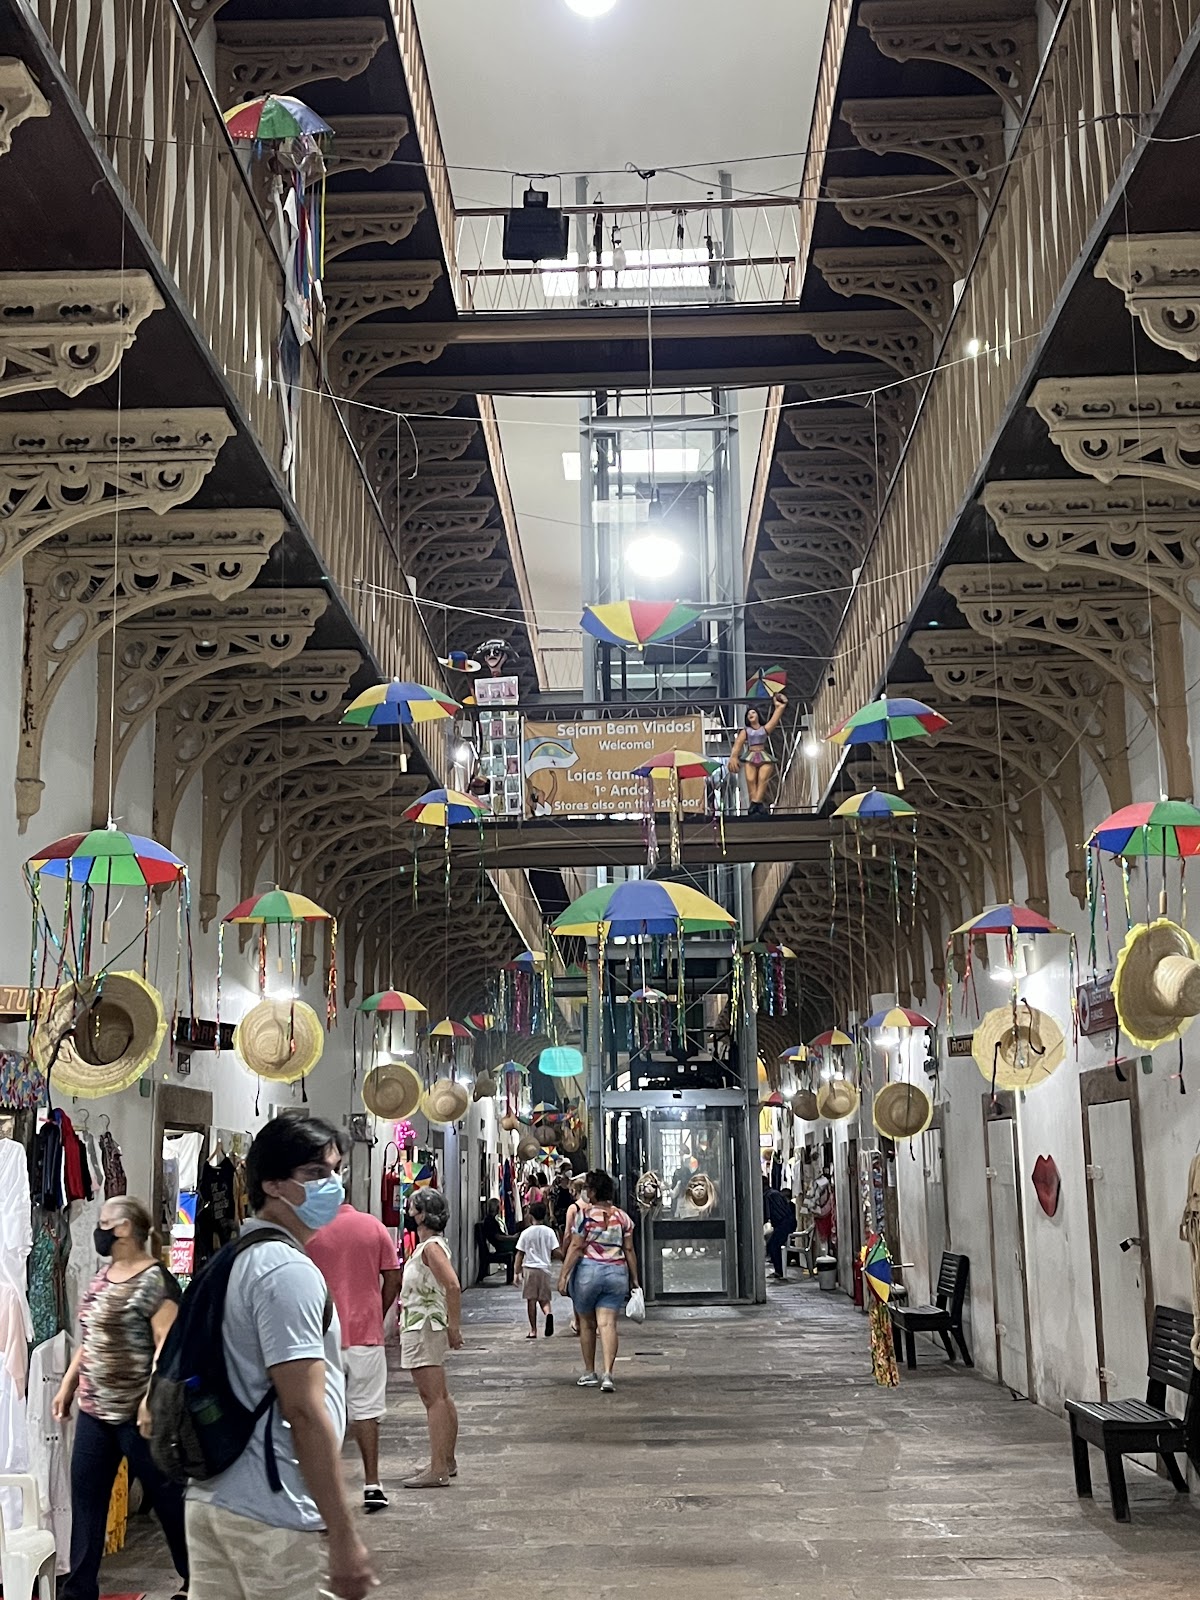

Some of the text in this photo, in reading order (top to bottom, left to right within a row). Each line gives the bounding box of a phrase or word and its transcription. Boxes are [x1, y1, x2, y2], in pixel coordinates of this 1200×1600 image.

[557, 720, 695, 739] Sejam Bem Vindos!
[599, 739, 654, 750] Welcome!
[567, 769, 603, 783] Lojas
[554, 800, 589, 811] Stores
[592, 799, 613, 810] also
[618, 801, 631, 809] on
